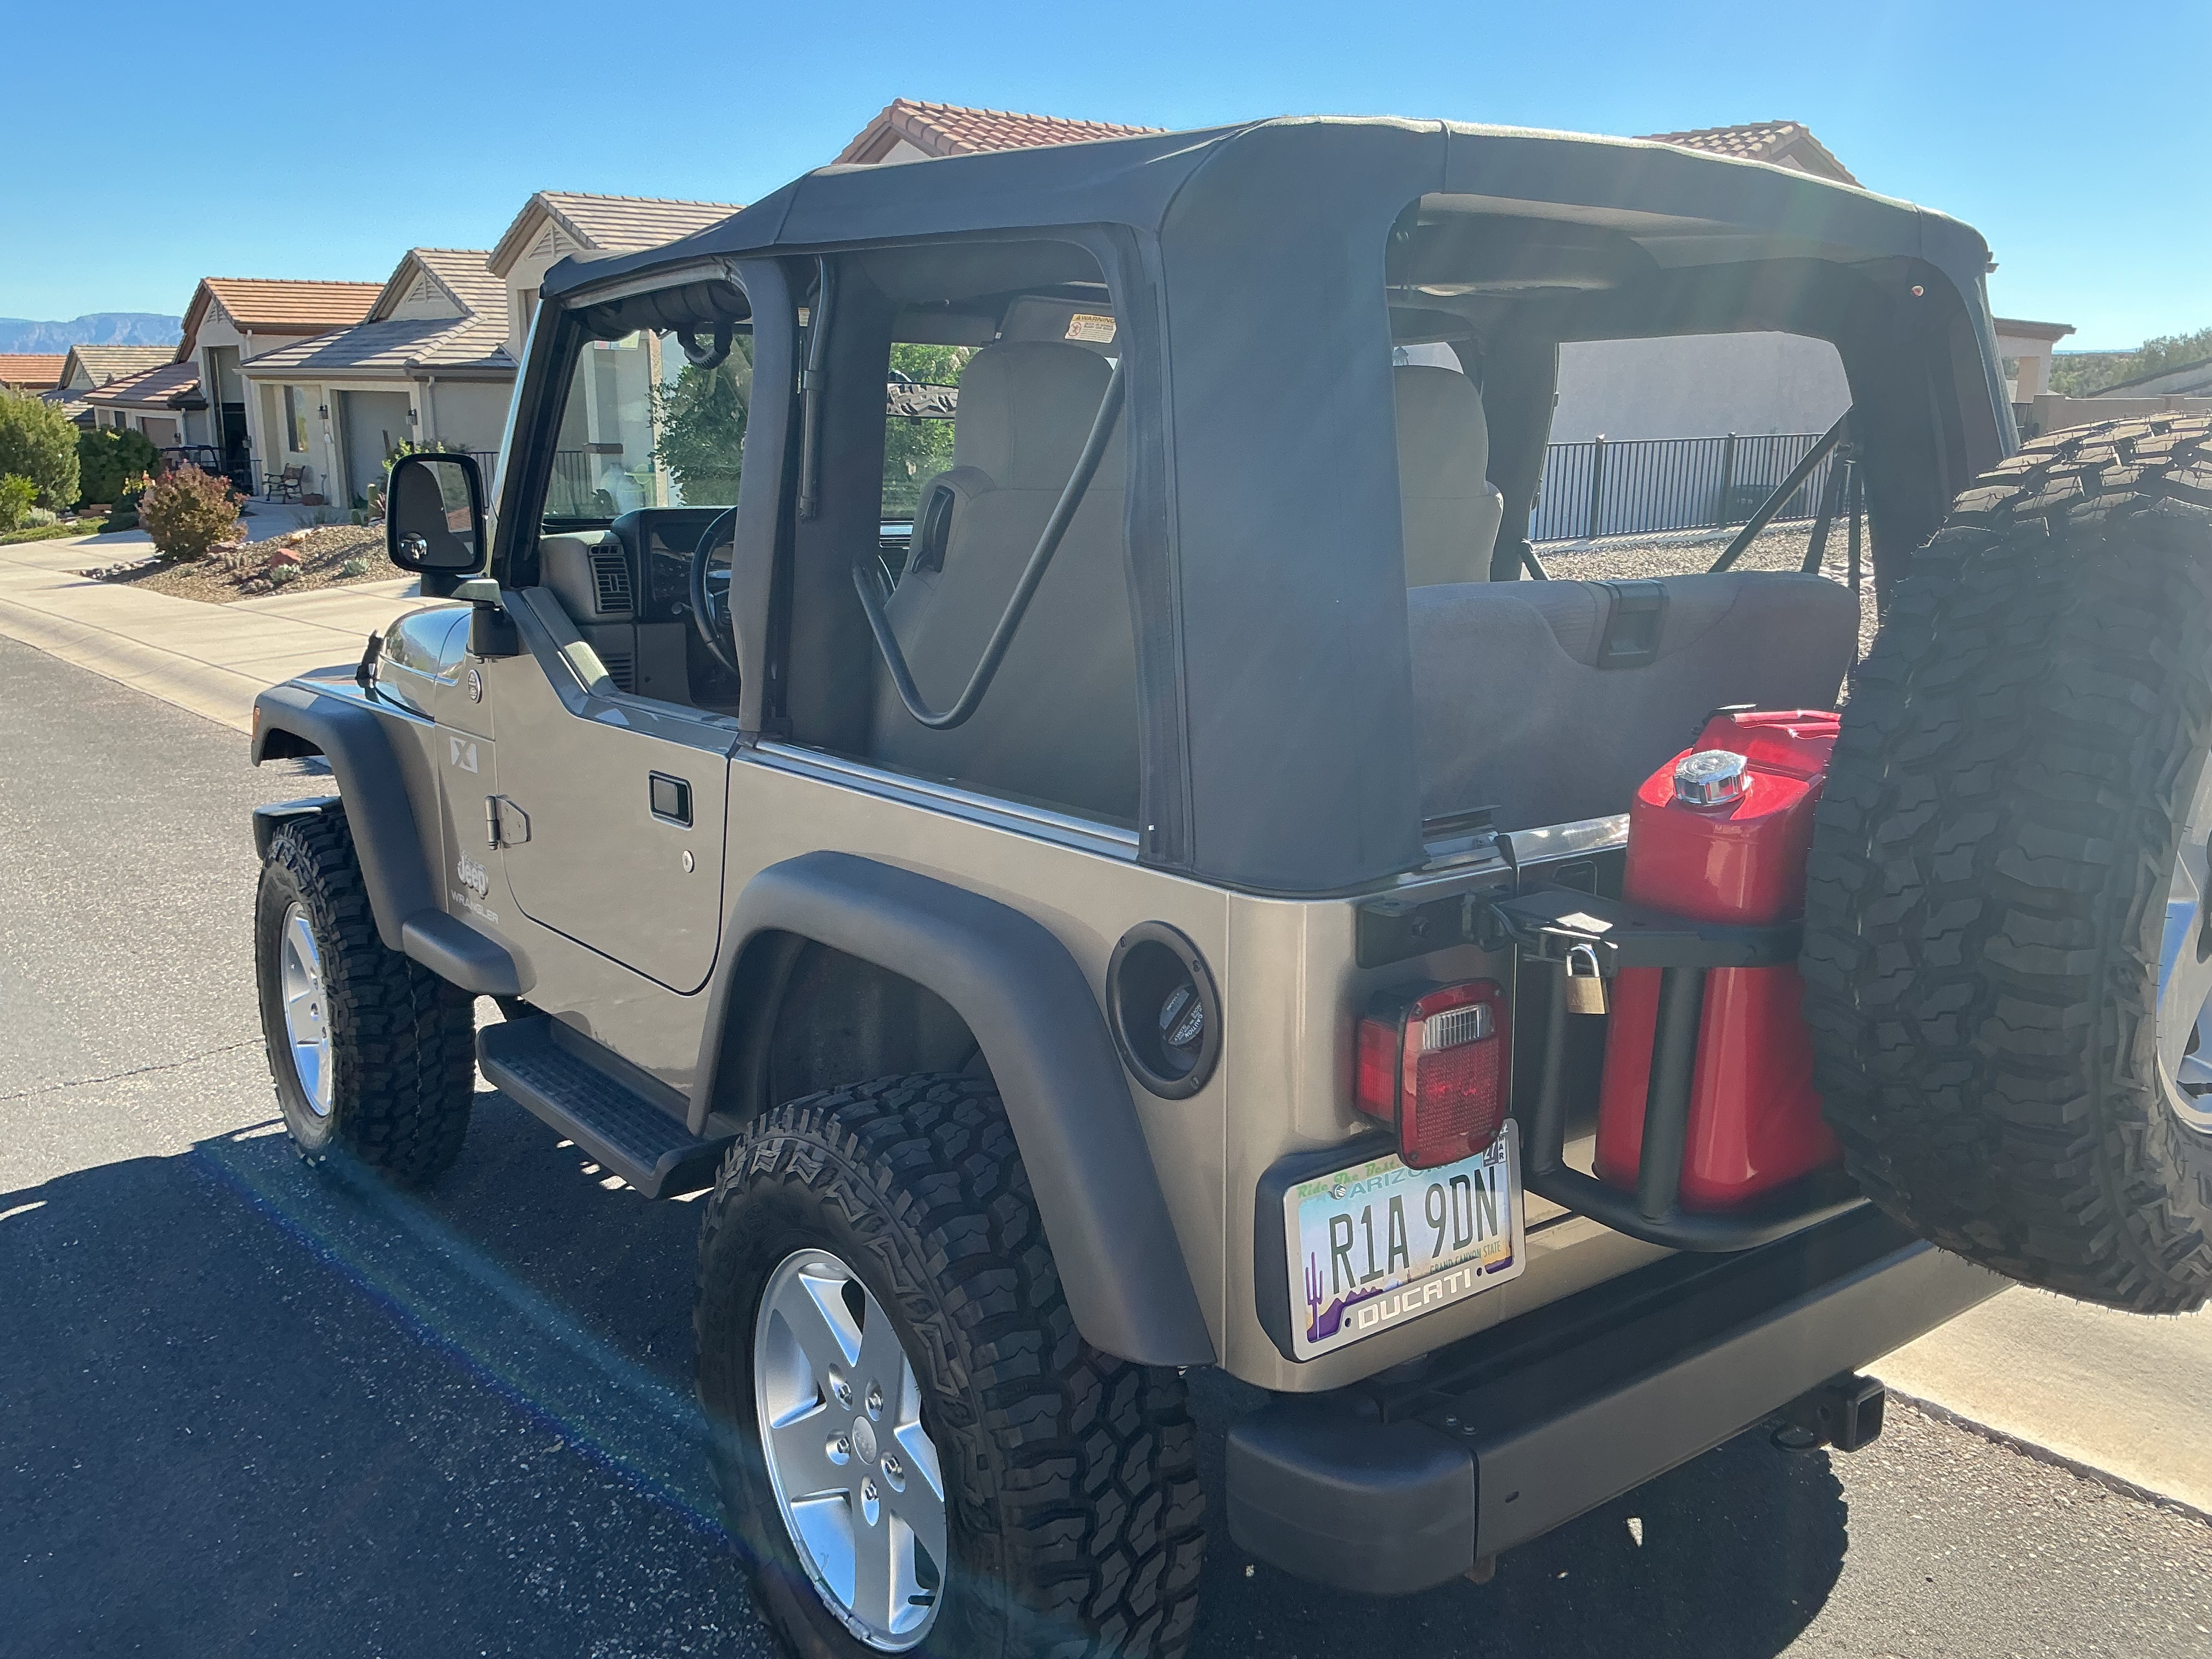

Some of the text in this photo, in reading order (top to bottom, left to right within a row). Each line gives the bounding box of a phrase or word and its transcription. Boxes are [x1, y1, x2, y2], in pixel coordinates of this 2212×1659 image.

[458, 851, 488, 900] Jeep
[450, 889, 499, 924] WRANGLER
[1184, 1014, 1203, 1038] CAUTION
[1297, 1182, 1328, 1198] Ride
[1334, 1172, 1358, 1185] The
[1329, 1166, 1498, 1294] R1A 9DN
[1430, 1240, 1500, 1272] GRAND CANYON STATE
[1358, 1268, 1471, 1330] DUCATI
